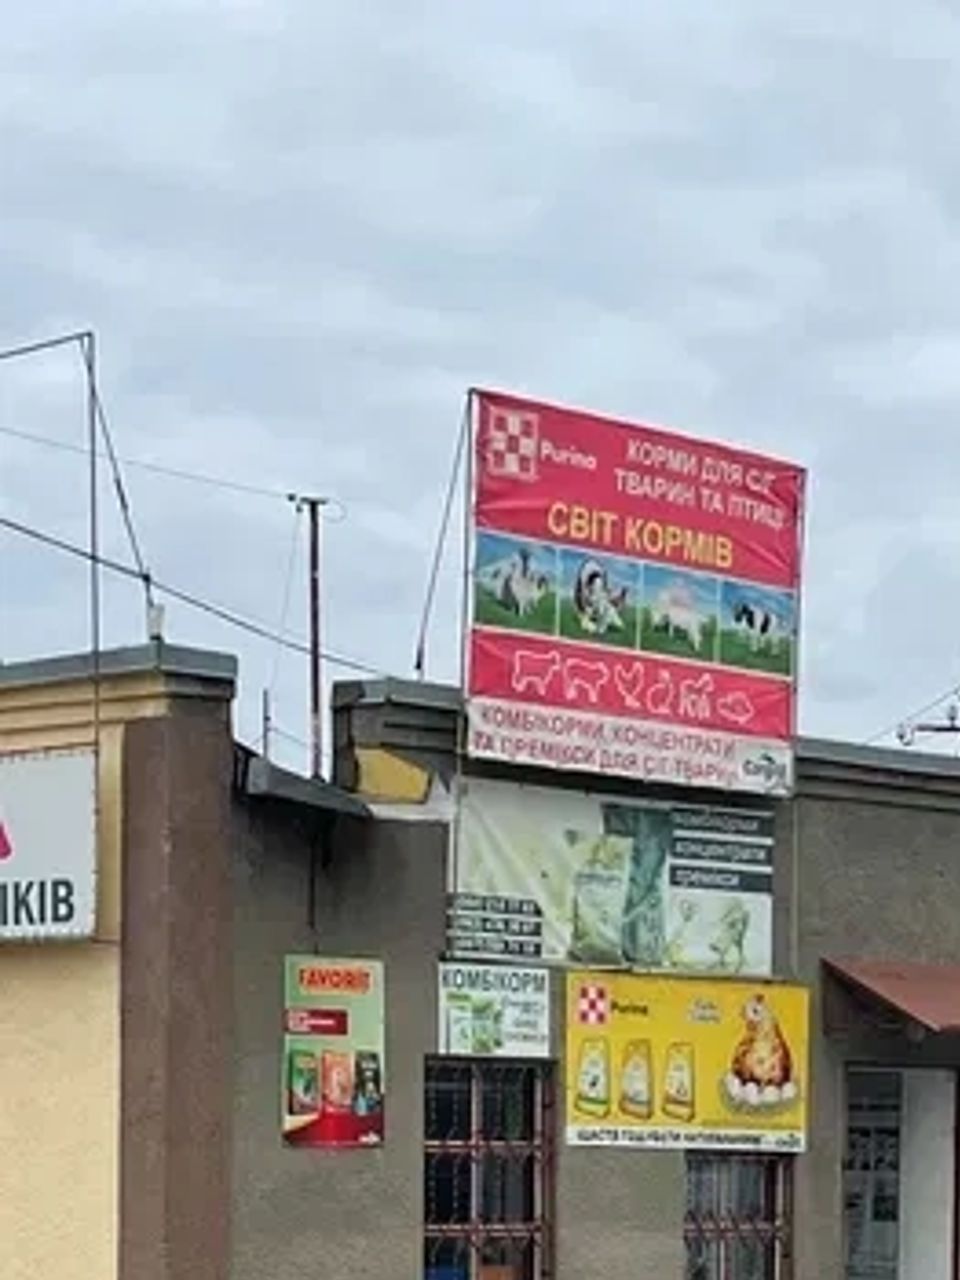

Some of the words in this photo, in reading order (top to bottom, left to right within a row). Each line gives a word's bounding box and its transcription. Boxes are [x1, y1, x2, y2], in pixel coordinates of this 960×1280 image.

[540, 441, 597, 470] Purina
[627, 438, 697, 477] КОРМИ
[701, 456, 745, 488] ДЛЯ
[614, 468, 695, 506] ТВАРИН
[700, 487, 725, 514] ТА
[547, 501, 618, 545] СВІТ
[624, 519, 733, 568] КОРМІВ
[474, 730, 495, 750] ТА
[600, 750, 638, 770] ДЛЯ
[442, 968, 546, 992] КОМБІКОРМ
